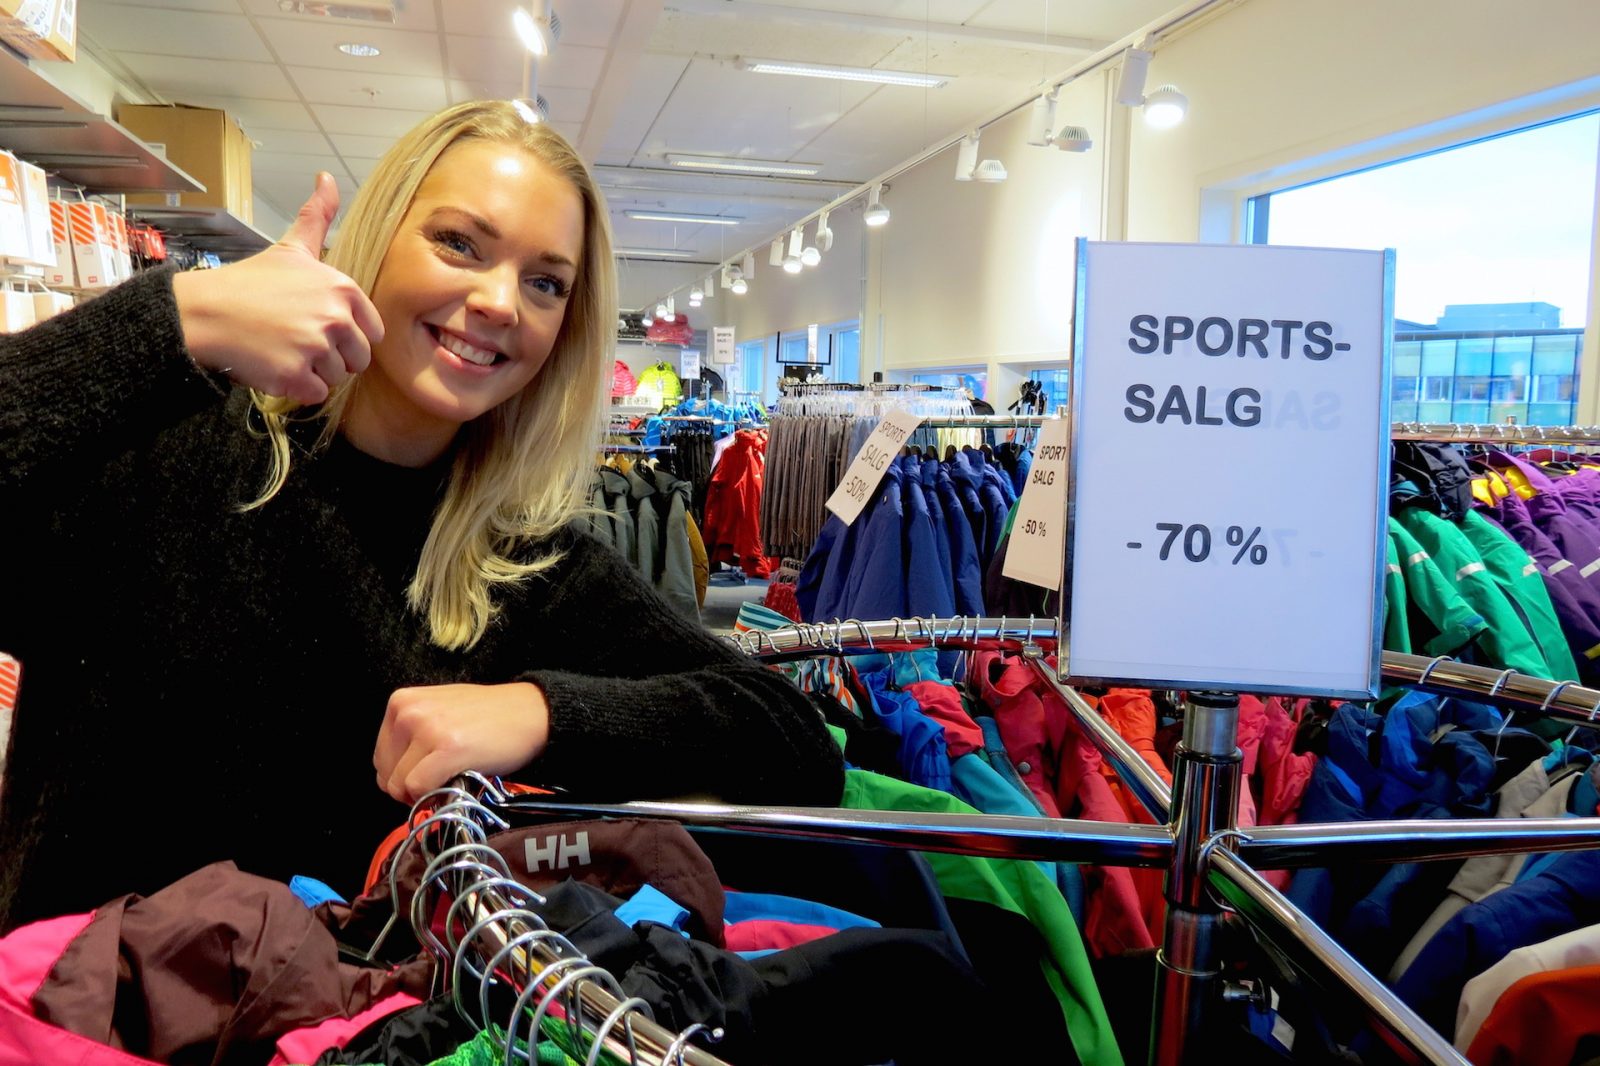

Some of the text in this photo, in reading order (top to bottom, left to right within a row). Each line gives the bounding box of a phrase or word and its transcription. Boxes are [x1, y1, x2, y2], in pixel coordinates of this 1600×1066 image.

[1128, 314, 1351, 361] SPORTS-
[1124, 383, 1261, 427] SALG
[879, 421, 906, 443] SPORTS
[861, 444, 888, 471] SALG
[1032, 469, 1055, 486] SALG
[524, 831, 591, 873] HH
